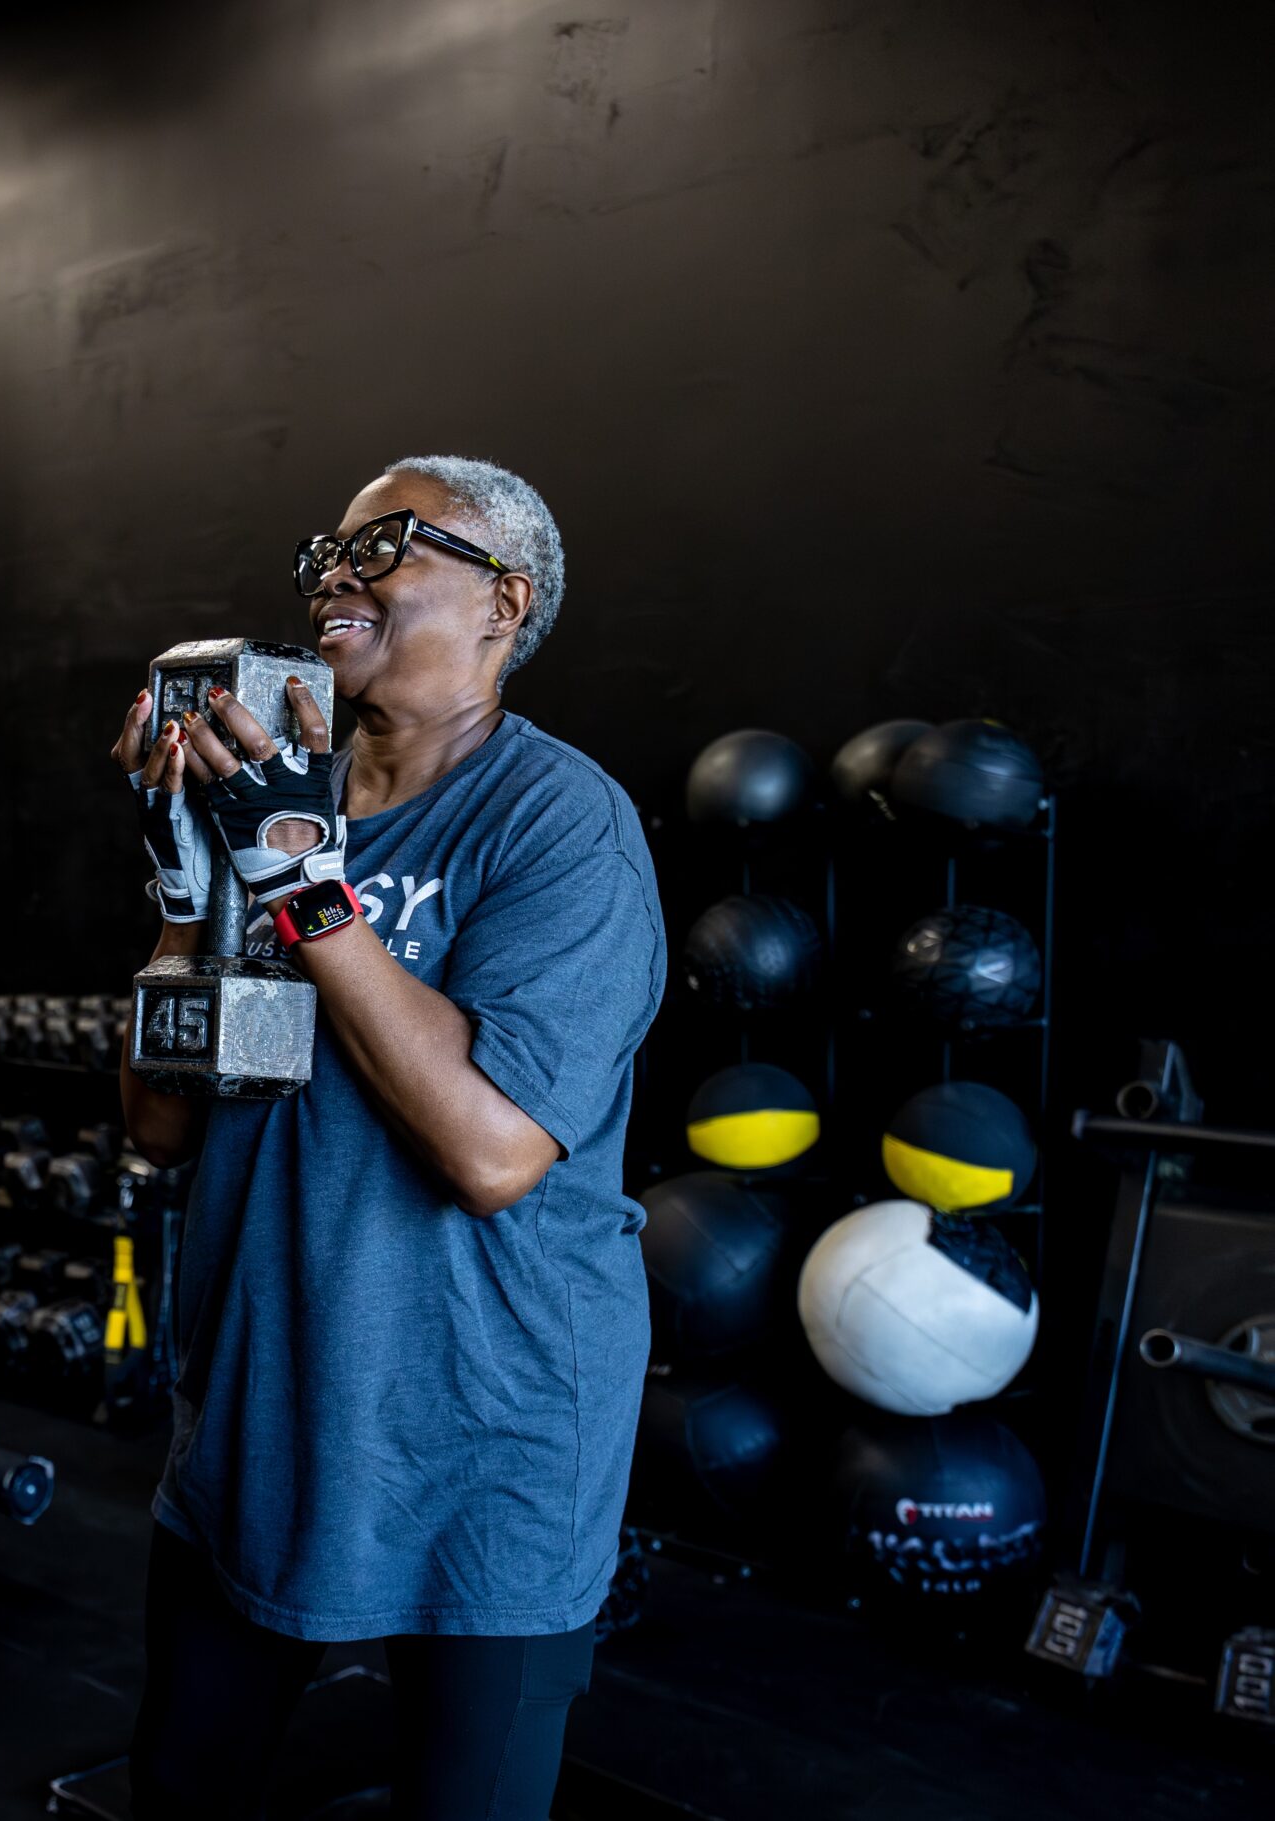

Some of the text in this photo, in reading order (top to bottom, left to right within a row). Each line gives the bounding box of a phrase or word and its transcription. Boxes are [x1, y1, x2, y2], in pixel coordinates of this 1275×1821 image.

[146, 997, 211, 1050] 45
[919, 1502, 995, 1520] TITAN
[1234, 1652, 1274, 1714] 100
